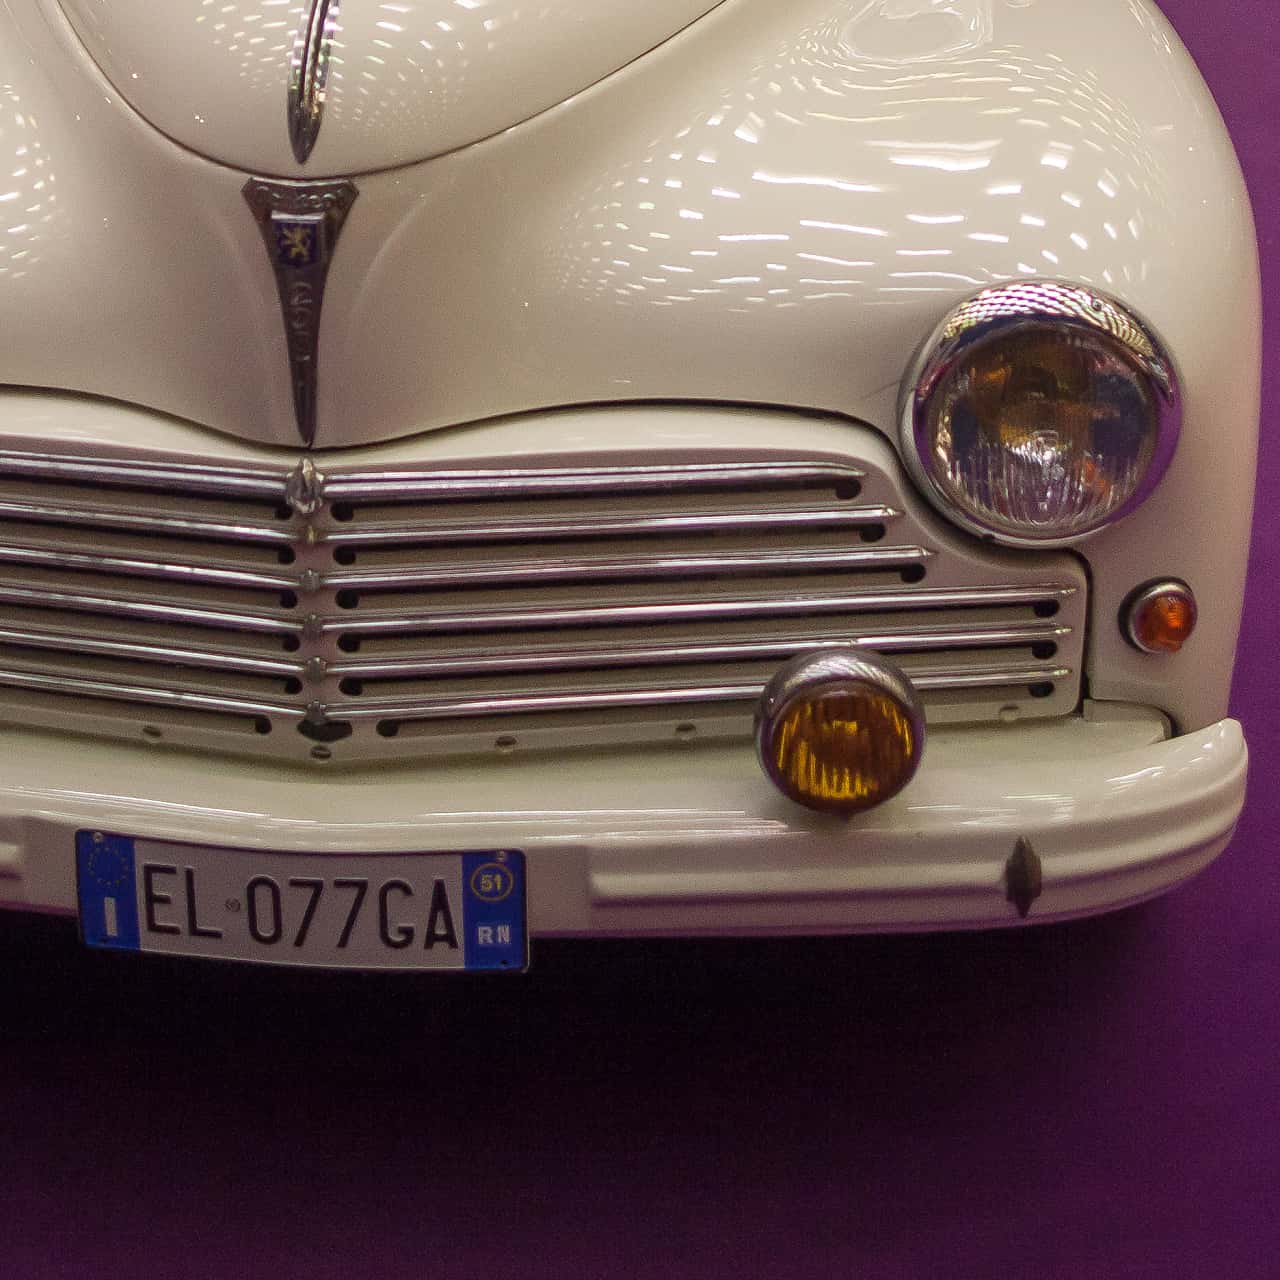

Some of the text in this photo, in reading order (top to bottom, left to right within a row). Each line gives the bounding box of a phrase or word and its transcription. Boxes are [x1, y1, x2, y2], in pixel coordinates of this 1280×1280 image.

[480, 873, 504, 892] 51
[142, 862, 460, 951] EL 077GA
[477, 924, 511, 946] RN
